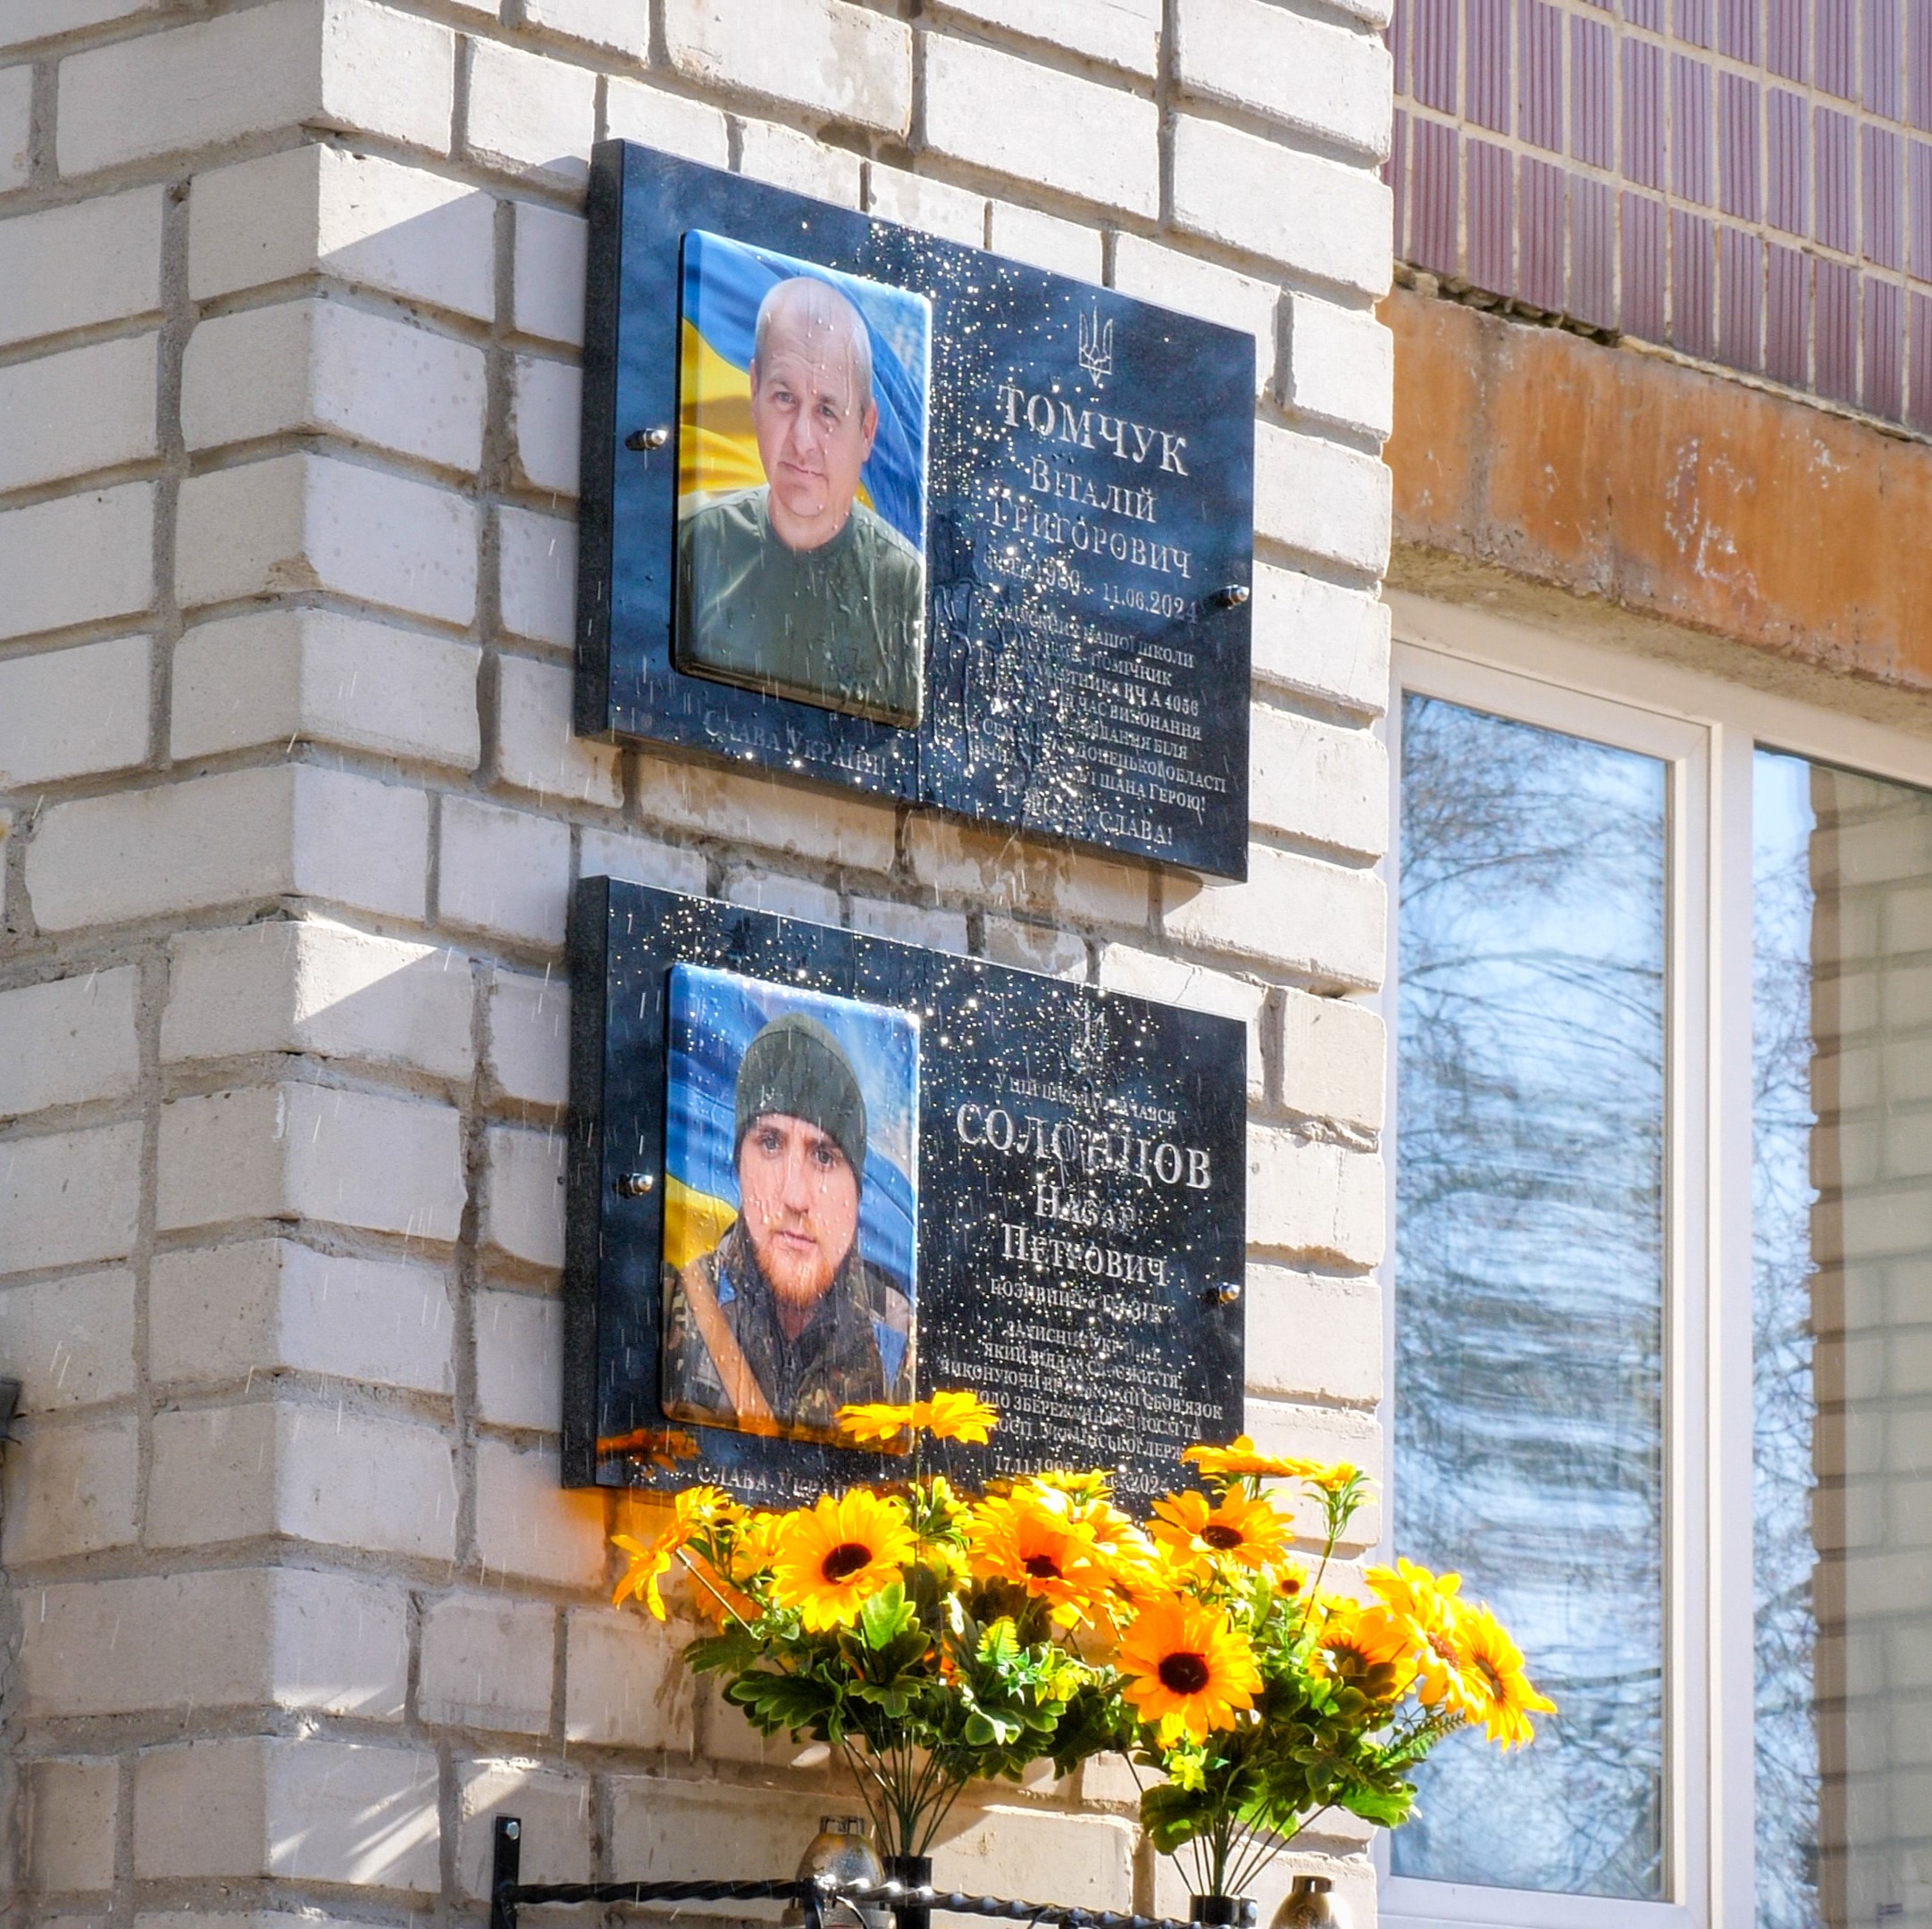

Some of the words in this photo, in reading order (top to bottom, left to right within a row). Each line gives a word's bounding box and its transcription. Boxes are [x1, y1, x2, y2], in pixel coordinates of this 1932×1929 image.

[999, 384, 1189, 476] ТОМЧУК
[1030, 456, 1157, 522] ВІТАЛІЙ
[992, 497, 1192, 579] ГРИГОРОВИЧ
[1103, 583, 1198, 623] 11.06.2024
[1083, 626, 1135, 653] НАШОЇ
[1138, 642, 1195, 668] ШКОЛИ
[1091, 652, 1173, 687] ПОМІЧНИК
[1079, 697, 1108, 718] ЧАС
[1150, 690, 1161, 707] А
[704, 711, 782, 751] СЛАВА
[1153, 738, 1189, 759] БІЛЯ
[1100, 772, 1146, 797] ШАНА
[1150, 784, 1206, 812] ГЕРОЮ!
[1165, 766, 1226, 792] ОБЛАСТІ
[1099, 812, 1173, 846] СЛАВА!
[1104, 1098, 1177, 1125] ВЧАВСЯ
[957, 1104, 1211, 1190] СОЛОНЦОВ
[1001, 1223, 1167, 1286] ПЕТРОВИЧ
[984, 1342, 1027, 1364] ЯКИЙ
[940, 1359, 1041, 1390] ВИКОНУЮЧИ
[1183, 1424, 1202, 1440] ТА
[698, 1463, 768, 1491] СЛАВА
